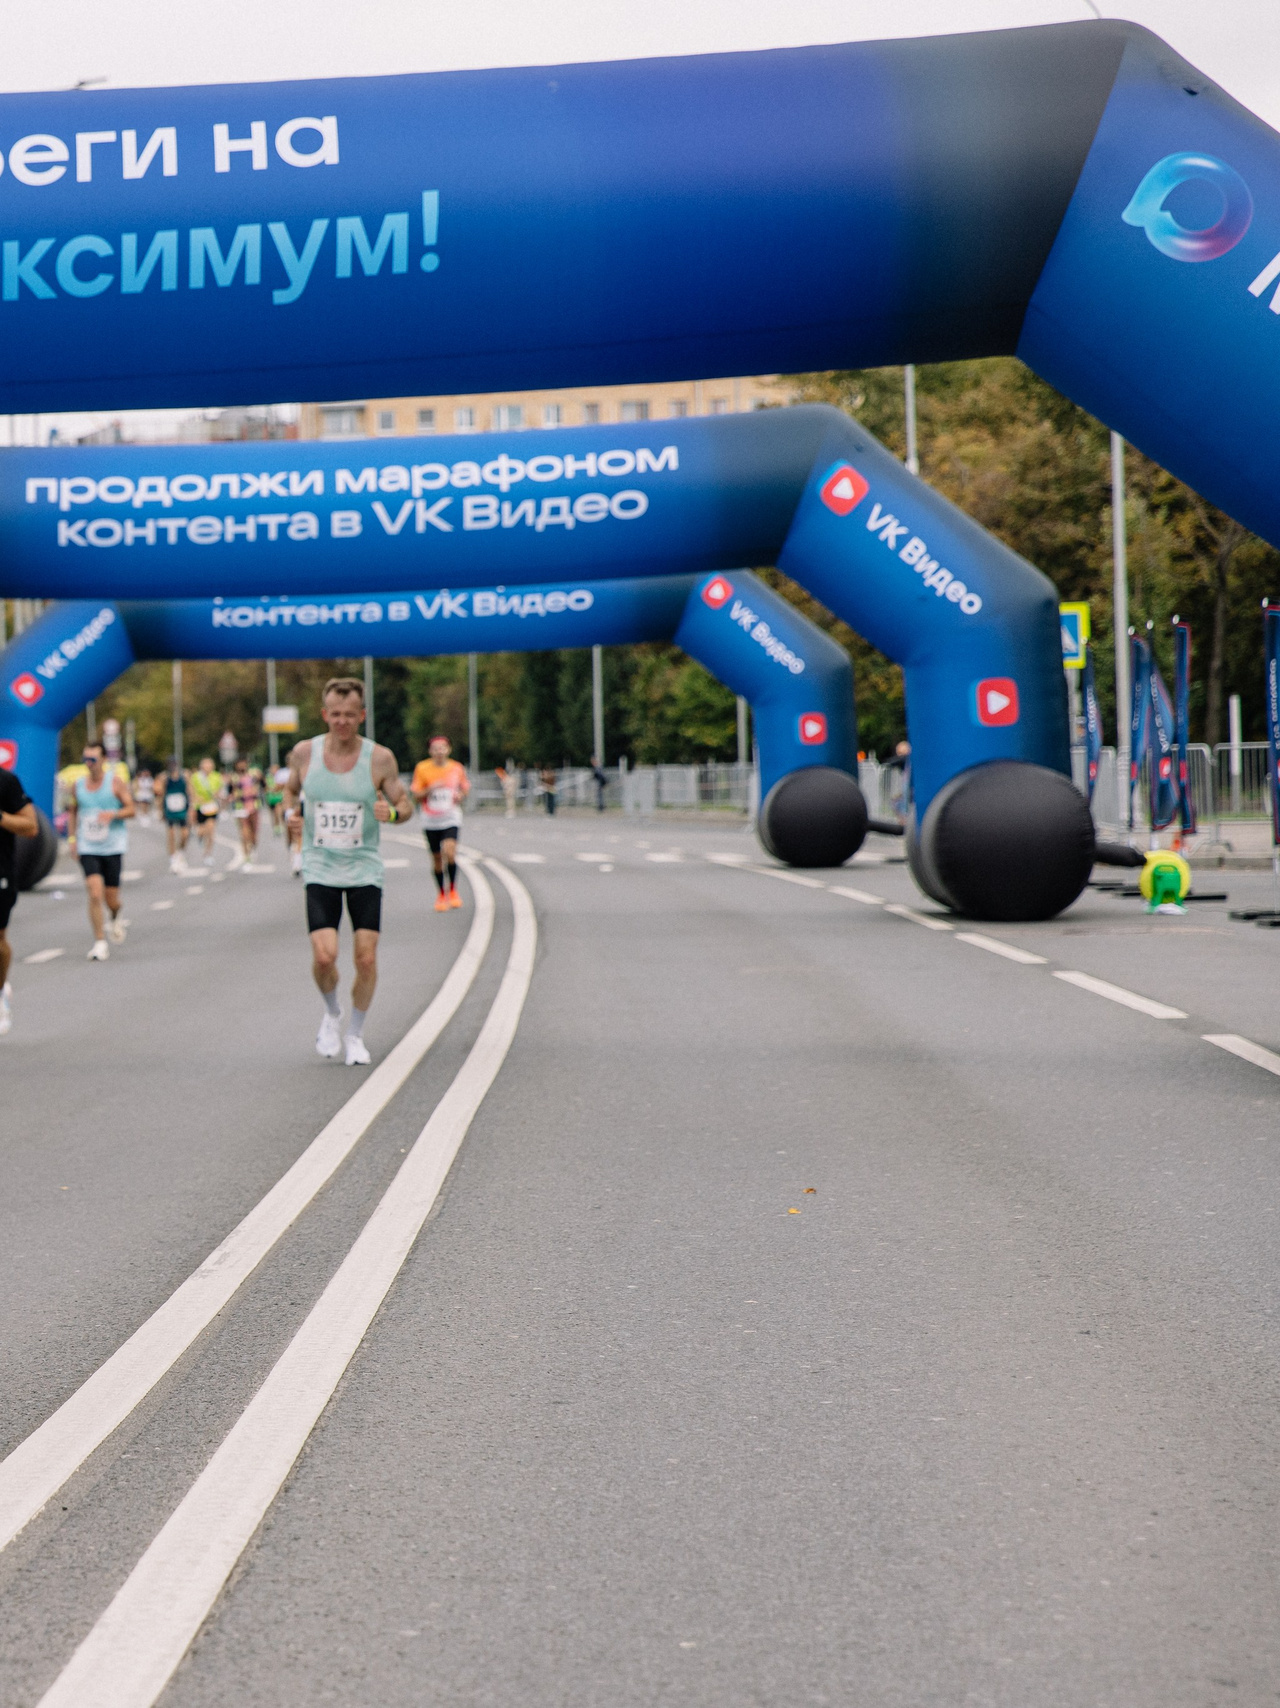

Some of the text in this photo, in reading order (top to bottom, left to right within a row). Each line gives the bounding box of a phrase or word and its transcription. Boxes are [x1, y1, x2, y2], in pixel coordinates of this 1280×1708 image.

[213, 115, 340, 173] на
[26, 446, 679, 510] продолжи марафоном
[58, 489, 649, 547] контента в VK Видео
[865, 503, 982, 615] VK Видео
[211, 602, 383, 628] контента
[414, 593, 469, 619] VK
[473, 589, 594, 618] Видео
[729, 600, 805, 674] VK Видео
